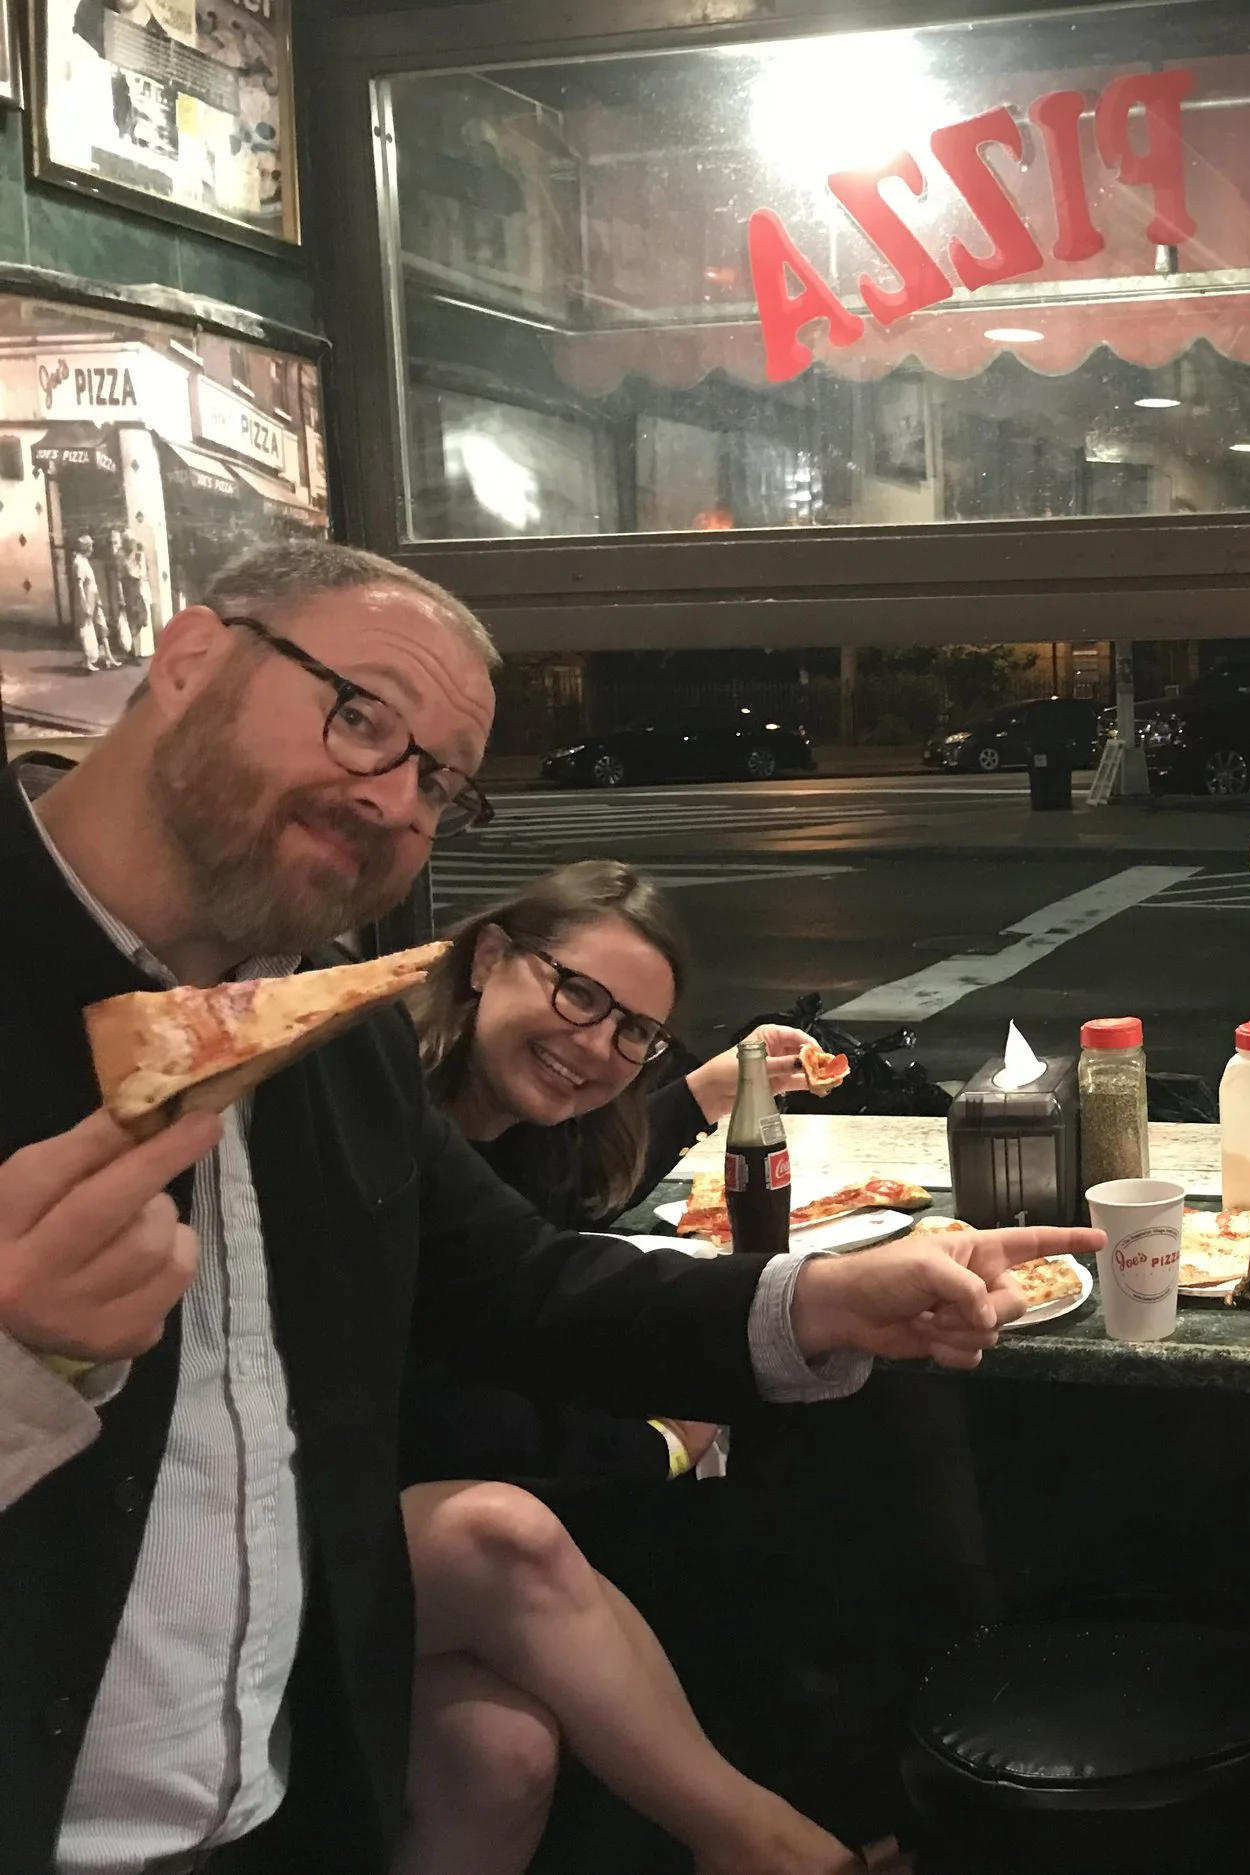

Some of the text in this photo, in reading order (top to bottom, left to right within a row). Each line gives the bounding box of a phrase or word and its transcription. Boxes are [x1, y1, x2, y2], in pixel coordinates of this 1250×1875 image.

[75, 368, 137, 405] PIZZA
[241, 414, 279, 459] PIZZA
[63, 450, 90, 463] PIZZA
[1115, 1250, 1147, 1271] Joe's
